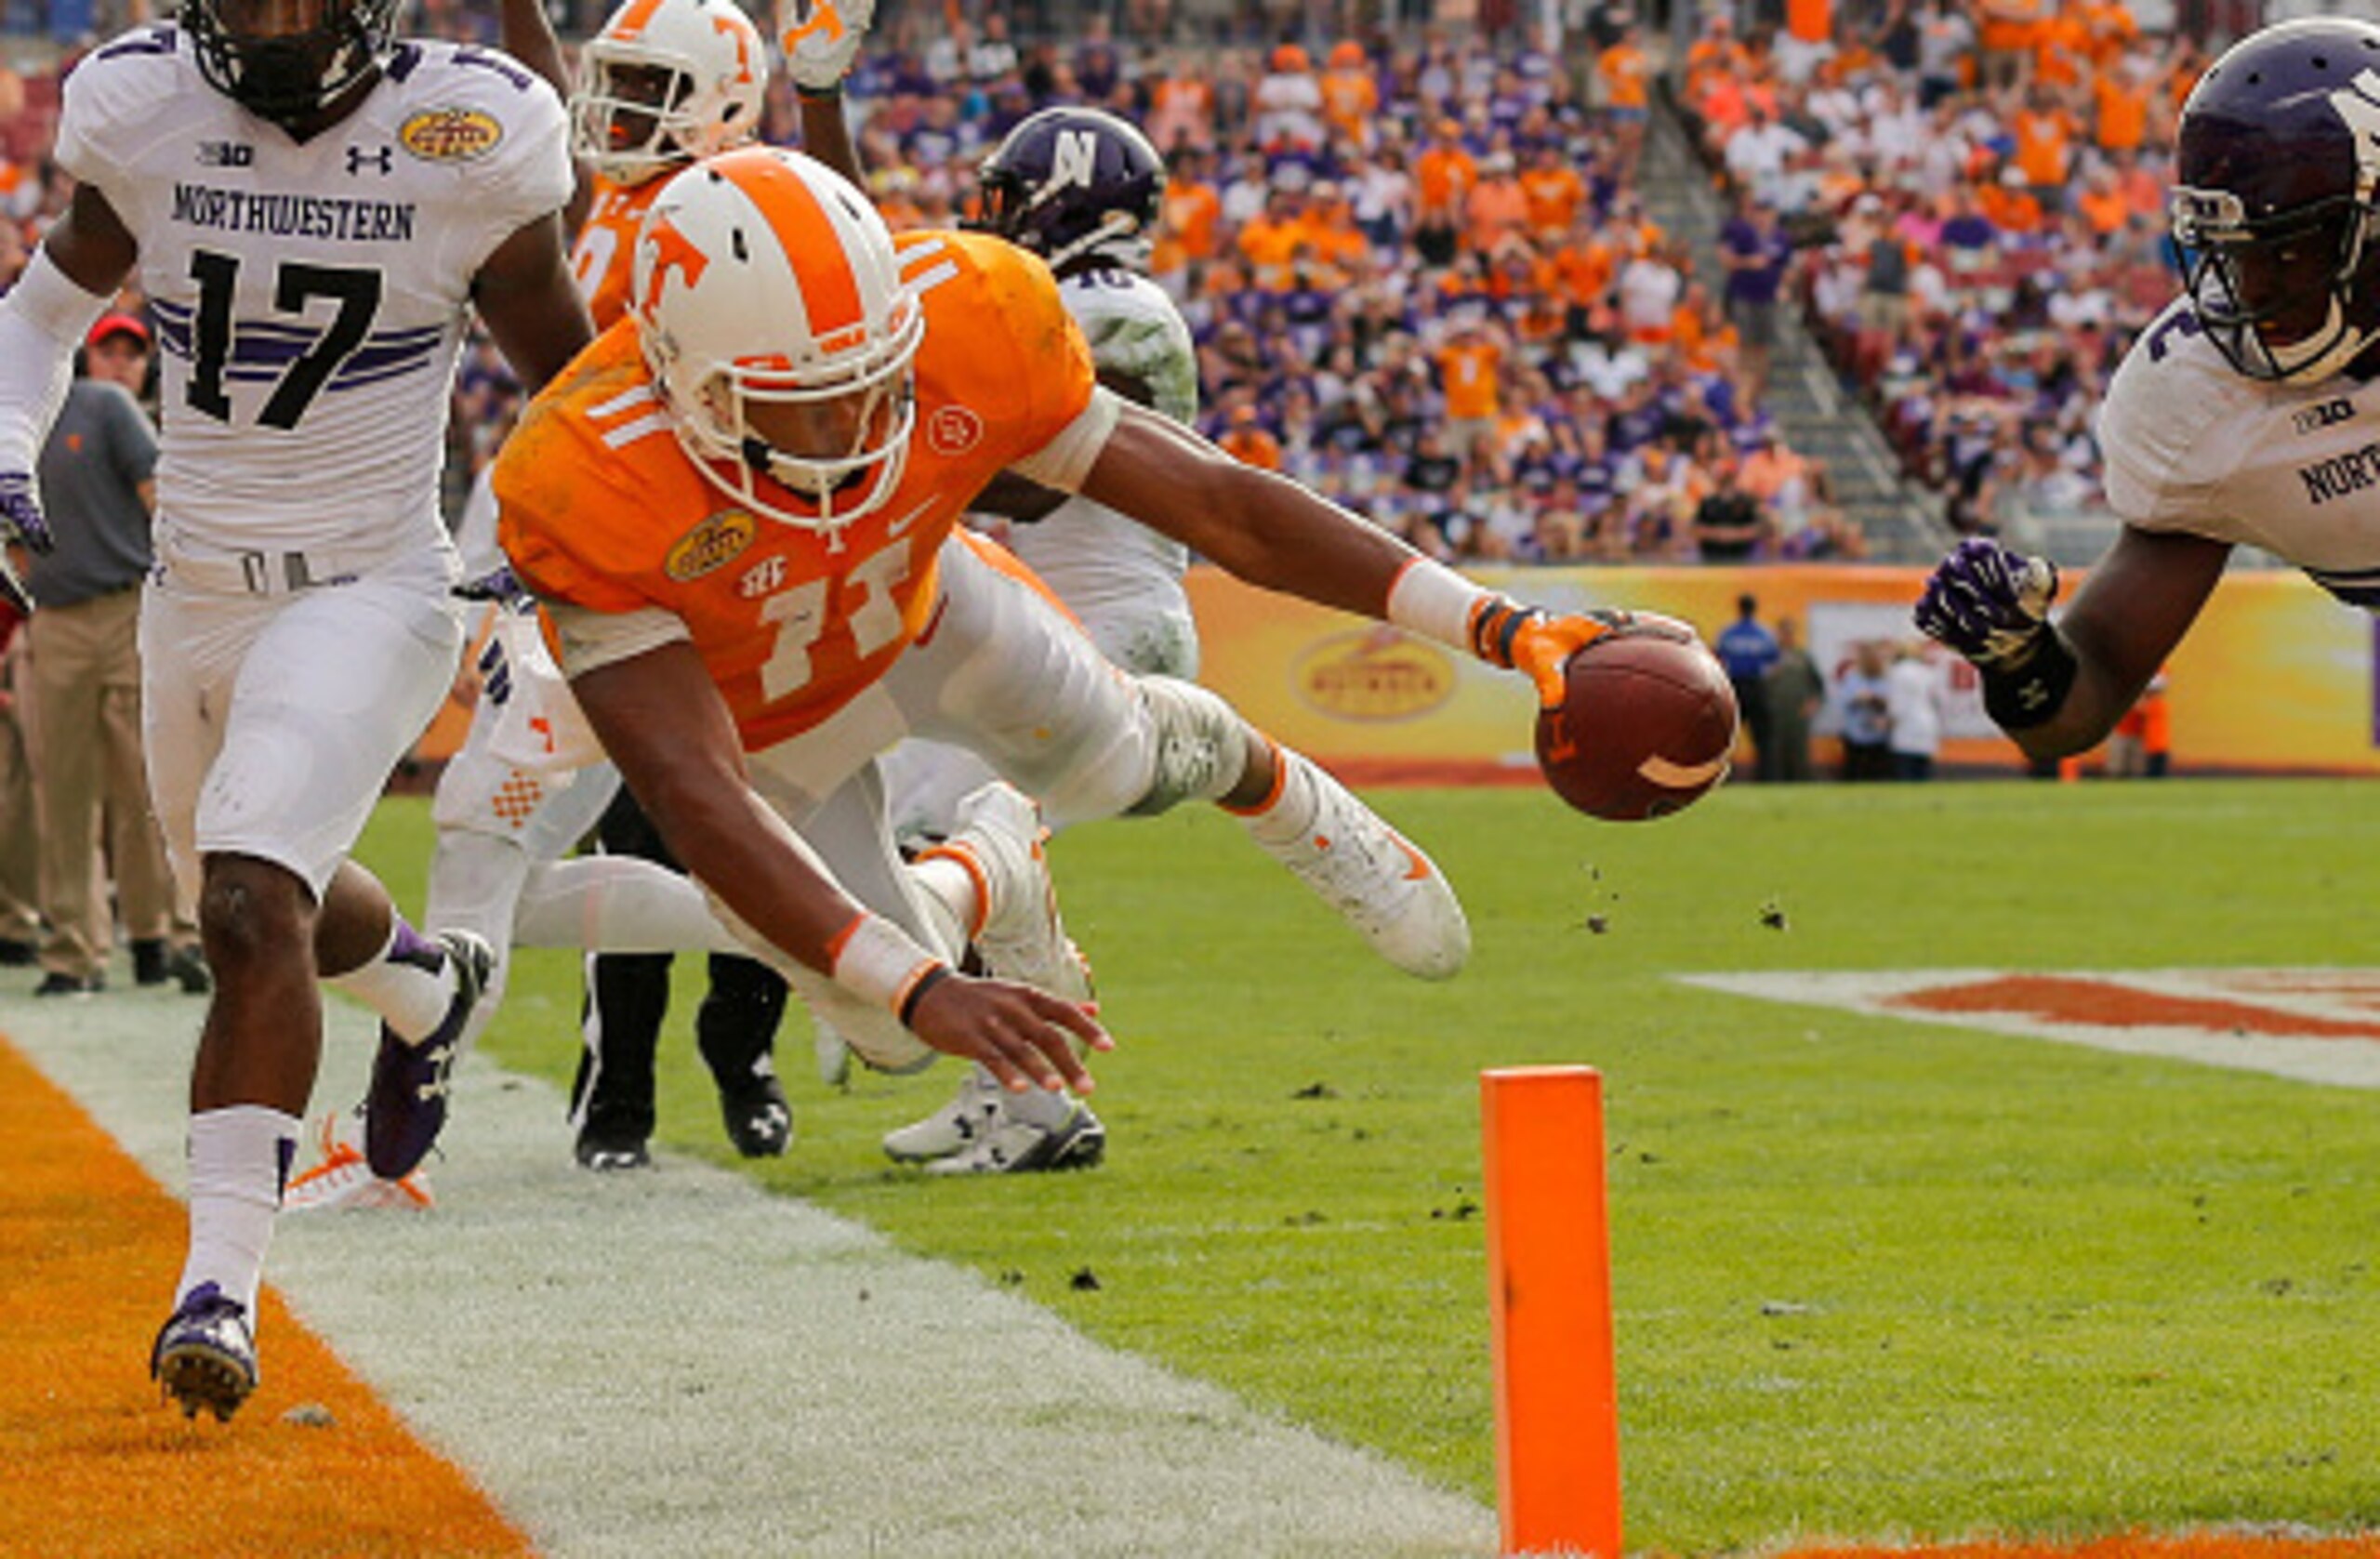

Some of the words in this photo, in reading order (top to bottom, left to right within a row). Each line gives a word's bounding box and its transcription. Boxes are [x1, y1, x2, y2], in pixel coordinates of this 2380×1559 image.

[1051, 129, 1097, 188] N
[171, 181, 416, 241] NORTHWESTERN
[186, 248, 383, 430] 17
